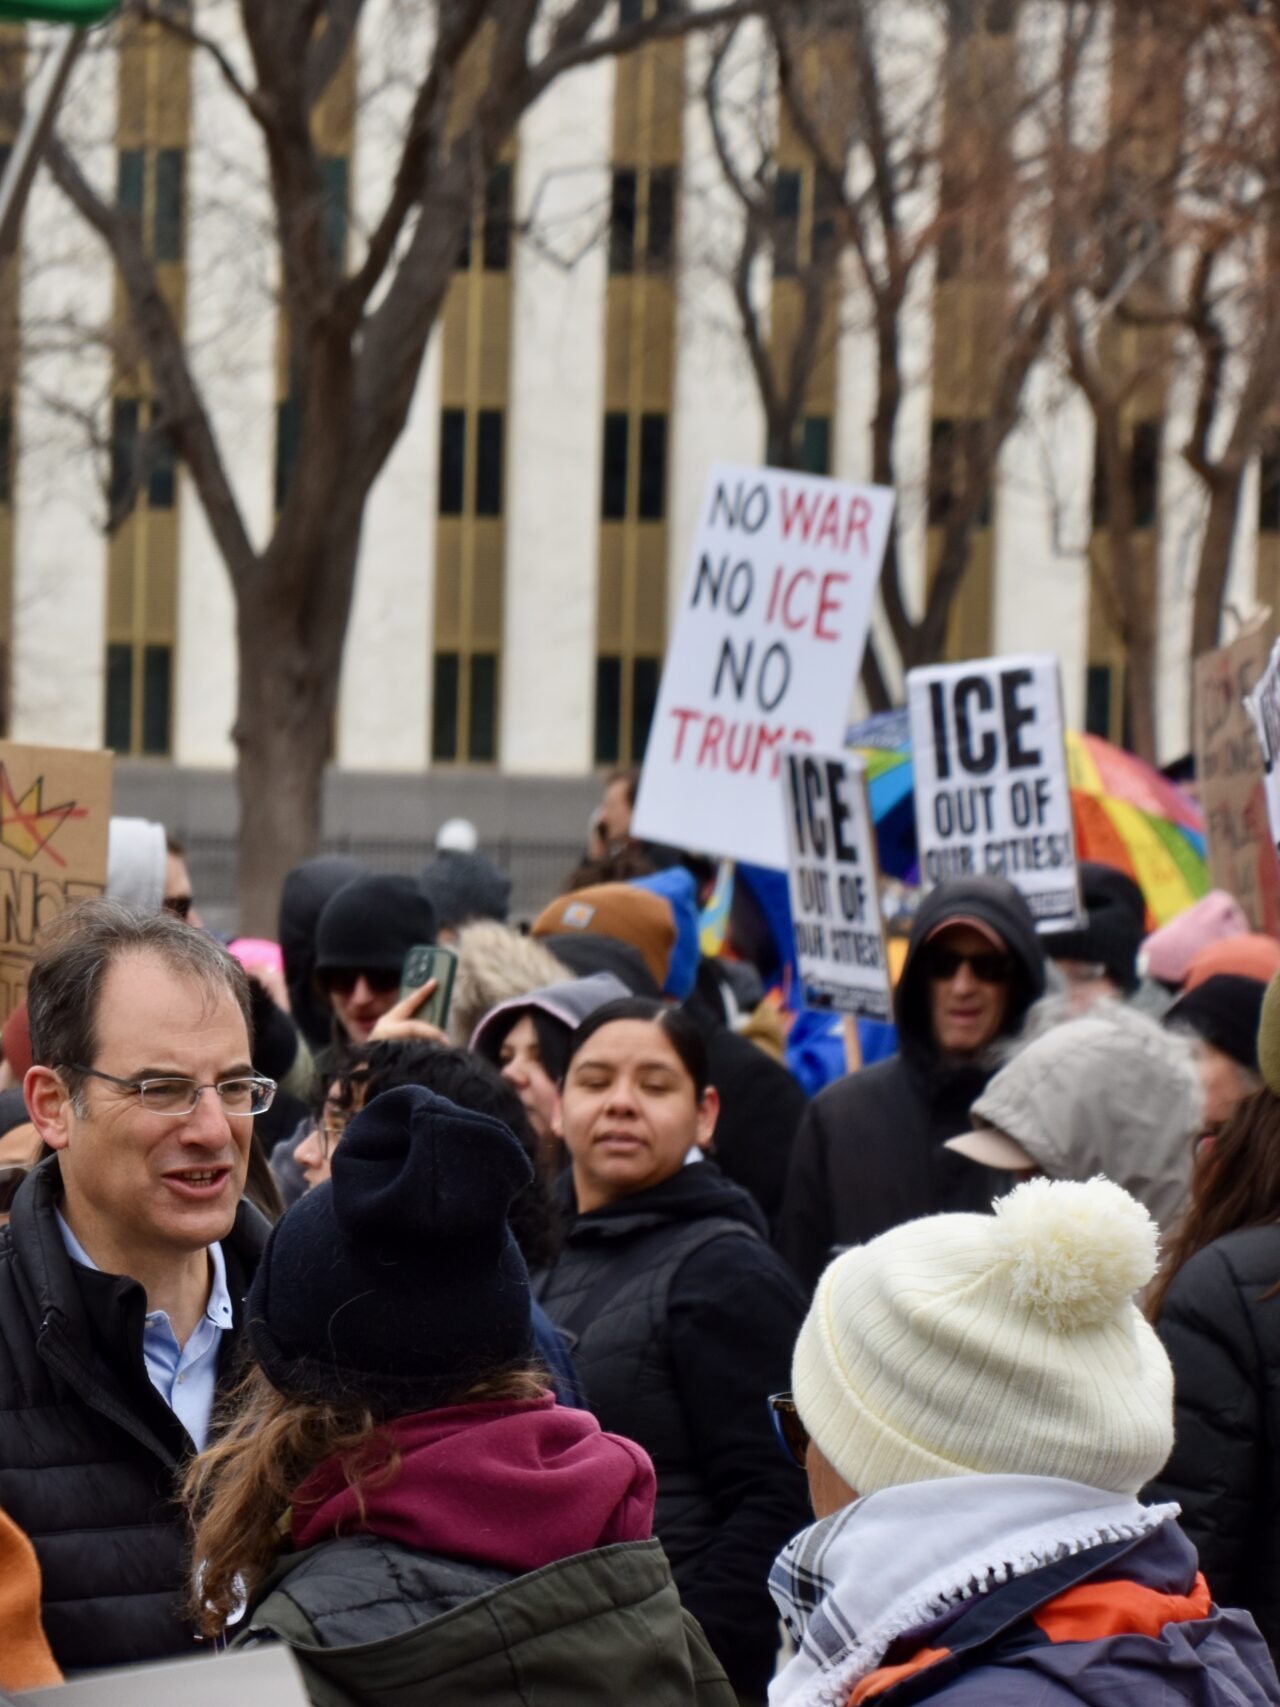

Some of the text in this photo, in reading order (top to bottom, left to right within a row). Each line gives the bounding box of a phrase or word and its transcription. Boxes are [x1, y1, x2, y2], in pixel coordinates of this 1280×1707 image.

[708, 481, 873, 559] NO WAR
[691, 551, 850, 641] NO ICE
[712, 636, 792, 713] NO
[929, 668, 1042, 780] ICE
[788, 755, 858, 864] ICE
[934, 778, 1052, 839] OUT OF
[798, 867, 866, 924] OUT OF
[925, 844, 974, 882] OUR
